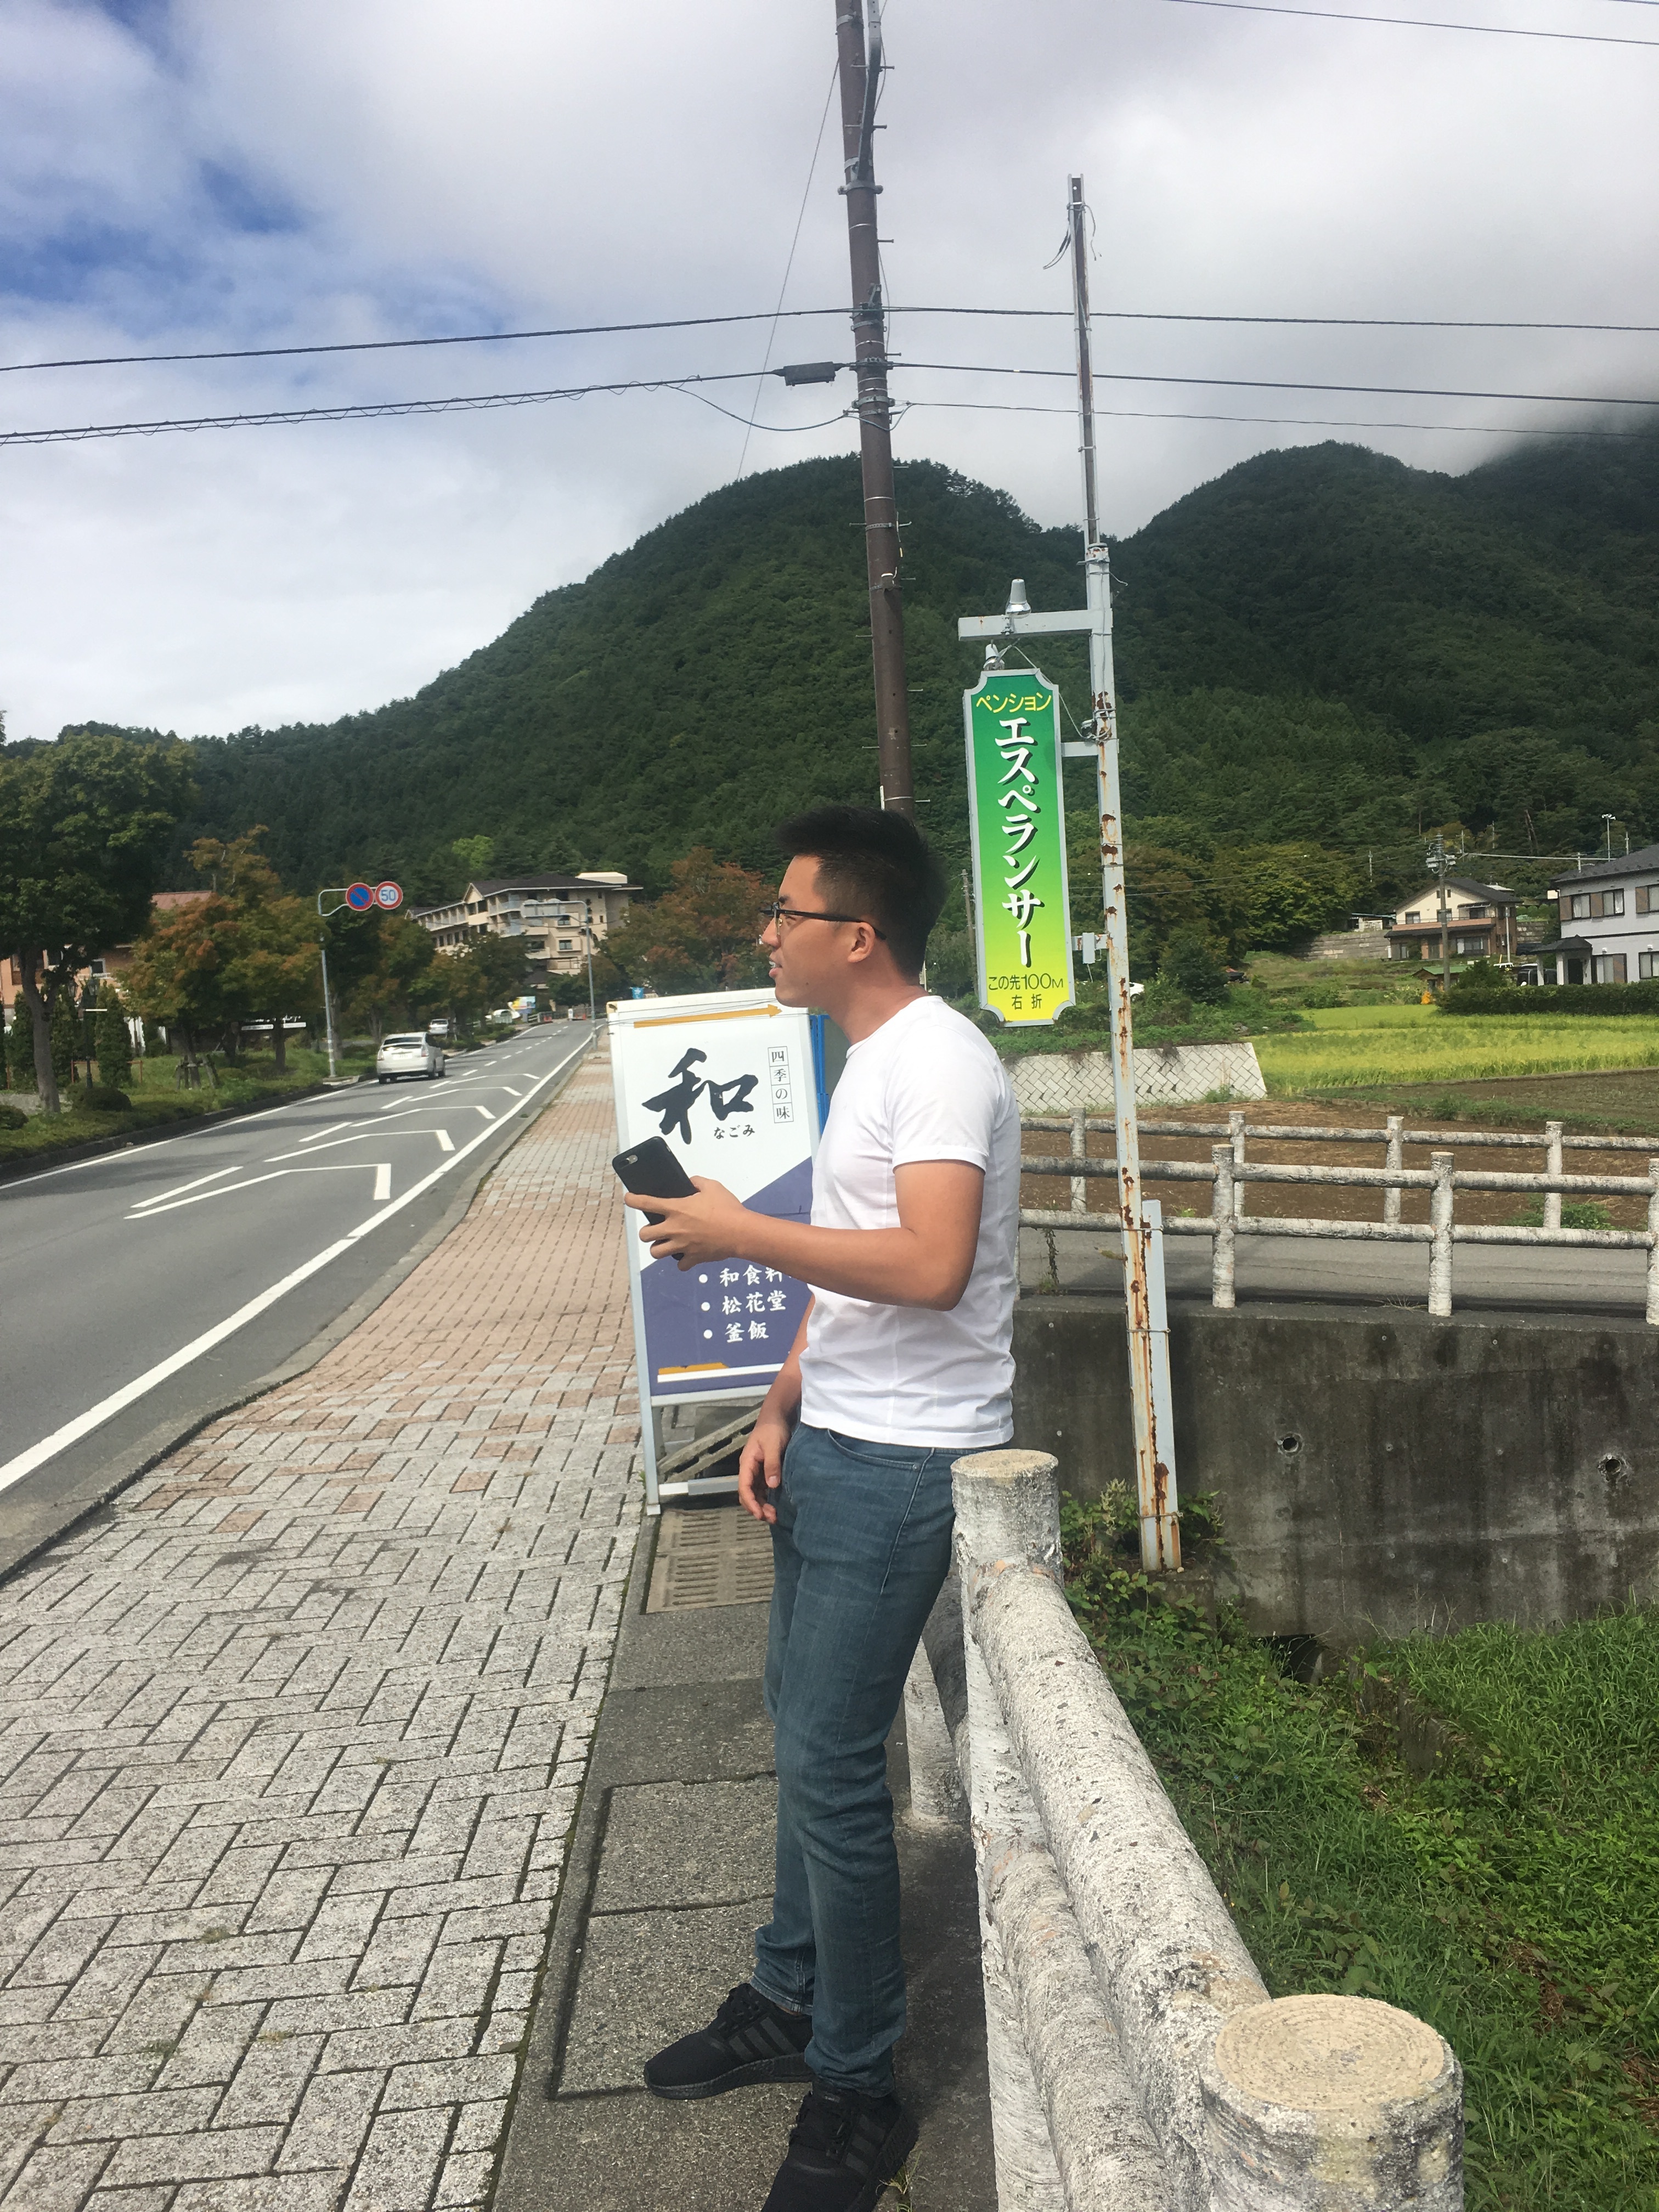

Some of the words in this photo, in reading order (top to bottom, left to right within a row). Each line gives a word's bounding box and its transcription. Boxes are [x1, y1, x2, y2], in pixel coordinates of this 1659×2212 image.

[976, 692, 1052, 713] ペンション
[994, 717, 1042, 967] エスペランサー
[381, 889, 396, 902] 50
[1011, 994, 1042, 1010] 右折
[641, 1047, 759, 1145] 和
[771, 1050, 791, 1120] 四季の味
[714, 1124, 755, 1139] なごみ
[719, 1265, 792, 1287] 和食料
[722, 1290, 787, 1315] 松花堂
[725, 1320, 769, 1342] 釜飯
